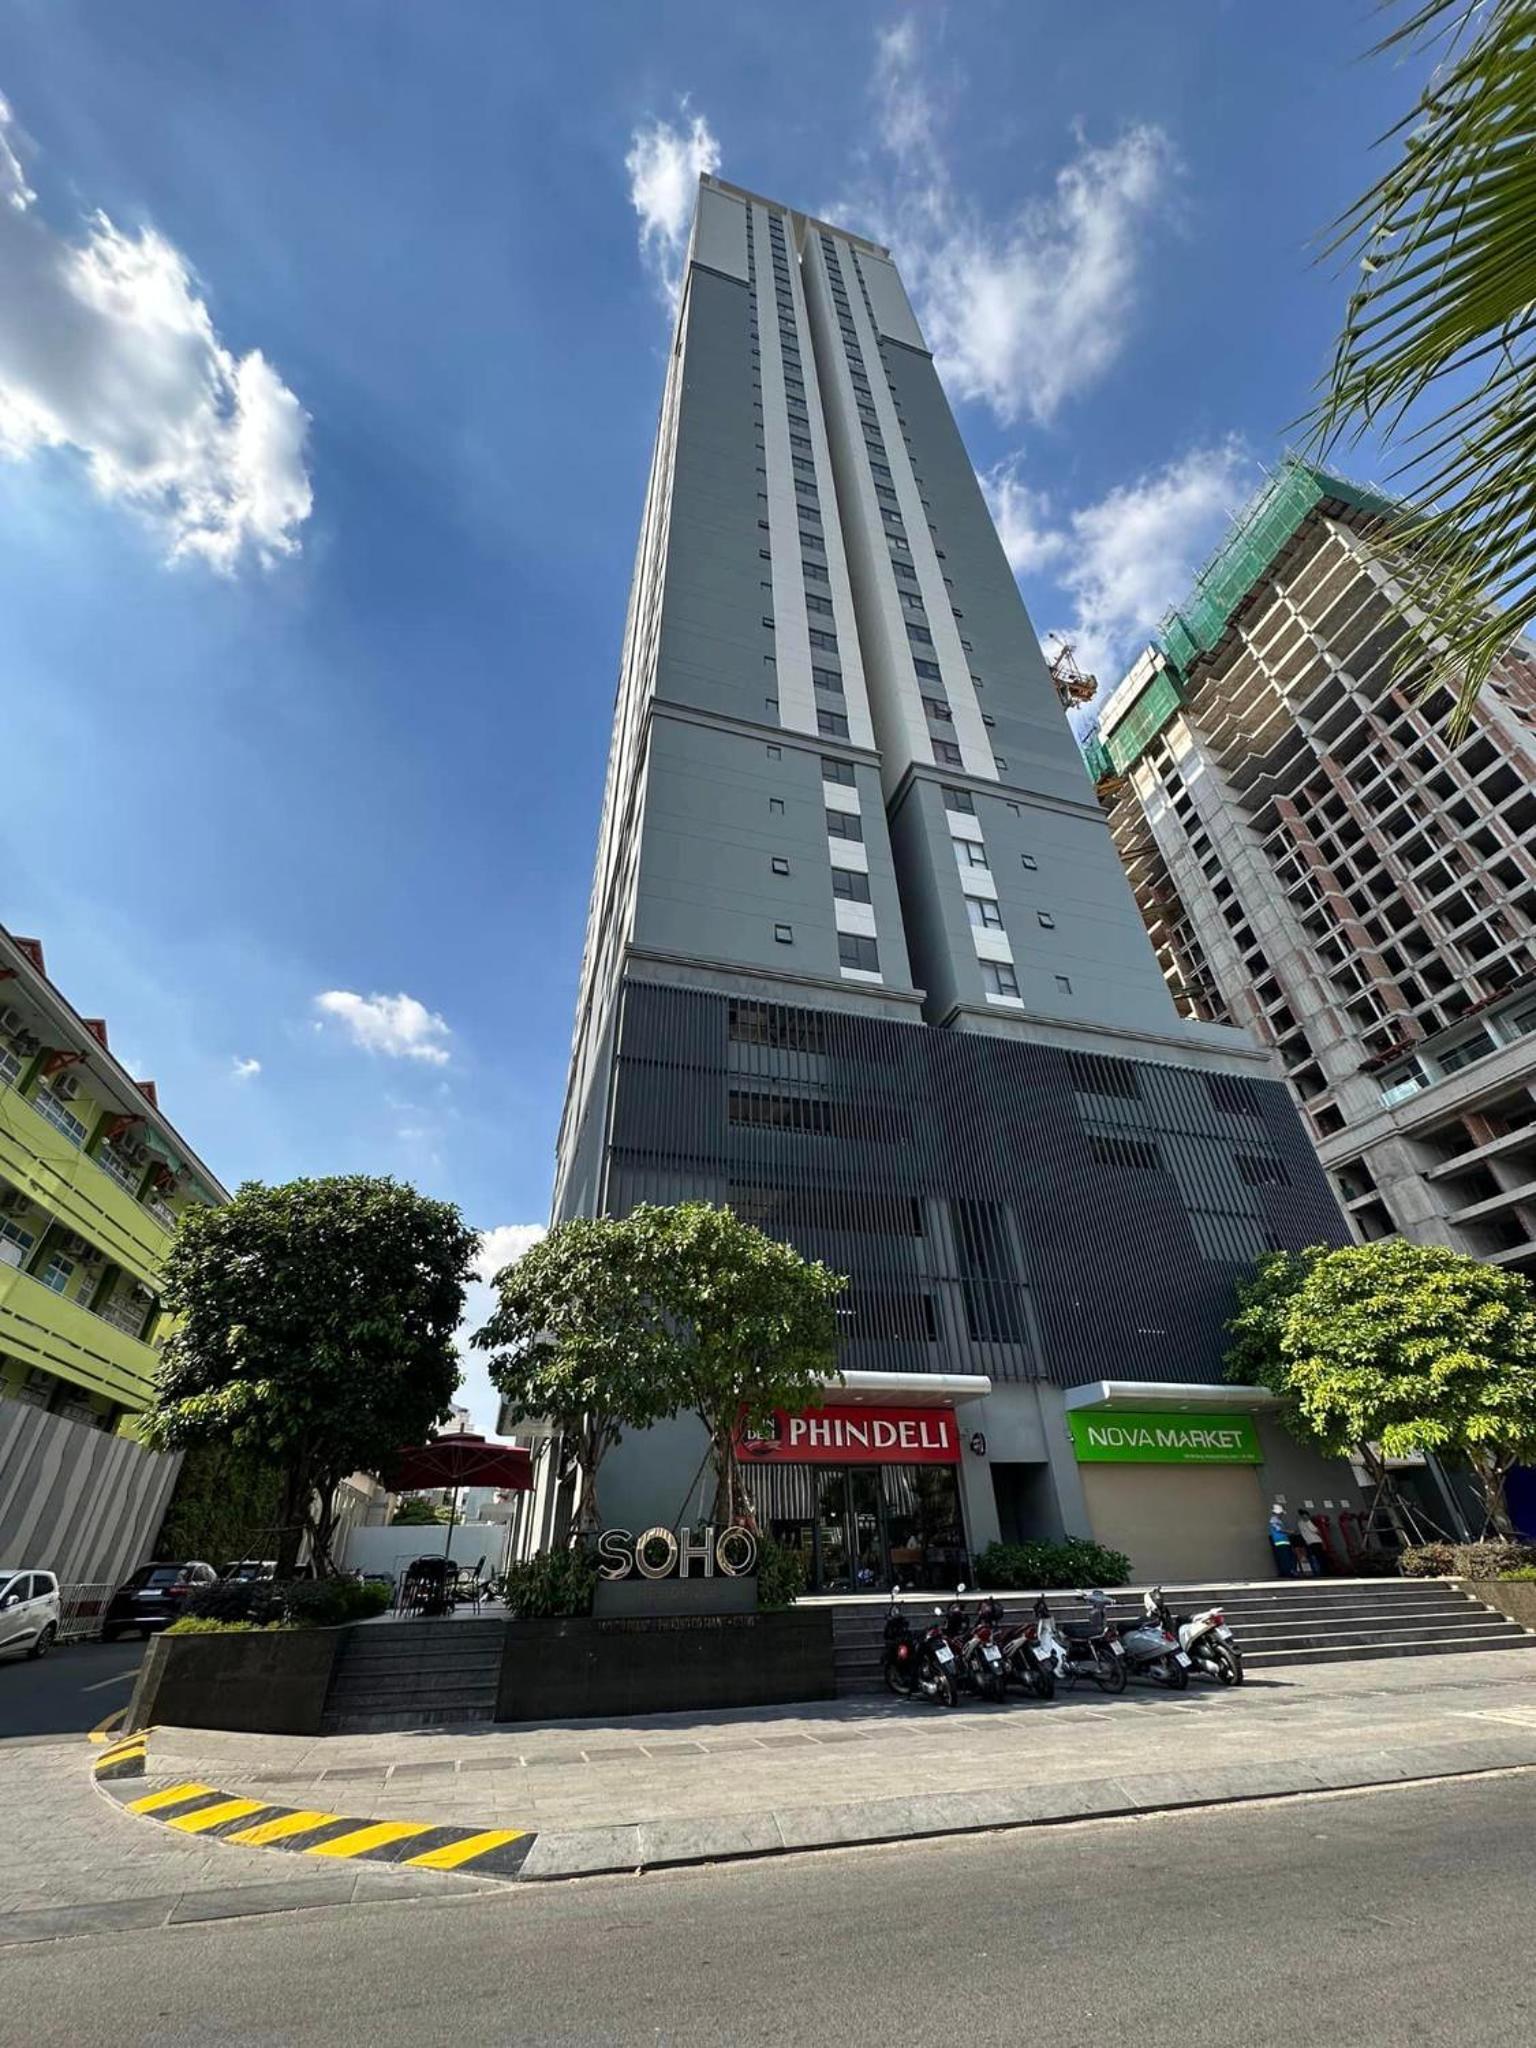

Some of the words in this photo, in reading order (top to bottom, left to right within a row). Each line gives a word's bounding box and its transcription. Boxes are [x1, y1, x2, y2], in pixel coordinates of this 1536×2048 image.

[790, 1418, 949, 1448] PHINDELI
[1088, 1426, 1155, 1447] NOVA
[1156, 1429, 1243, 1448] MARKET
[598, 1525, 758, 1580] SOHO
